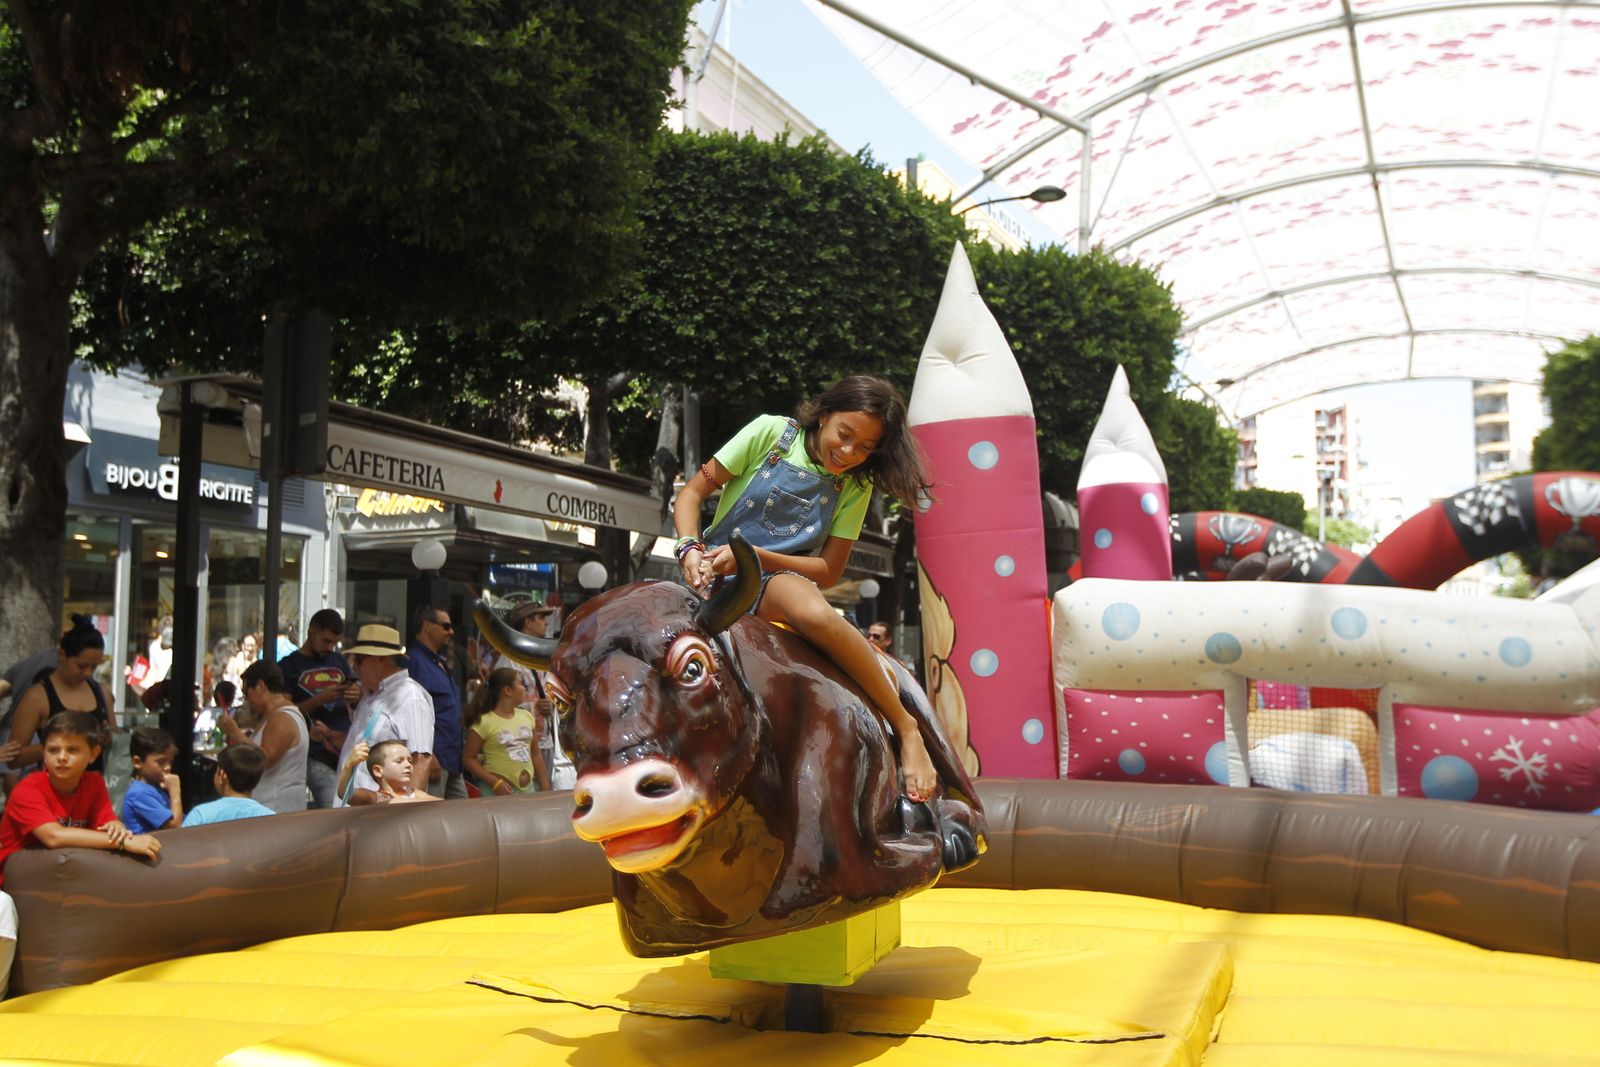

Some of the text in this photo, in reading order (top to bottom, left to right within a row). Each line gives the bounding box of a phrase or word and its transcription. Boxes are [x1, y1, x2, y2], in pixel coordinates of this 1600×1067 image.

[106, 463, 158, 490] BIJOU
[199, 478, 254, 504] RIGITTE
[326, 444, 445, 491] CAFETERIA
[546, 491, 618, 526] COIMBRA
